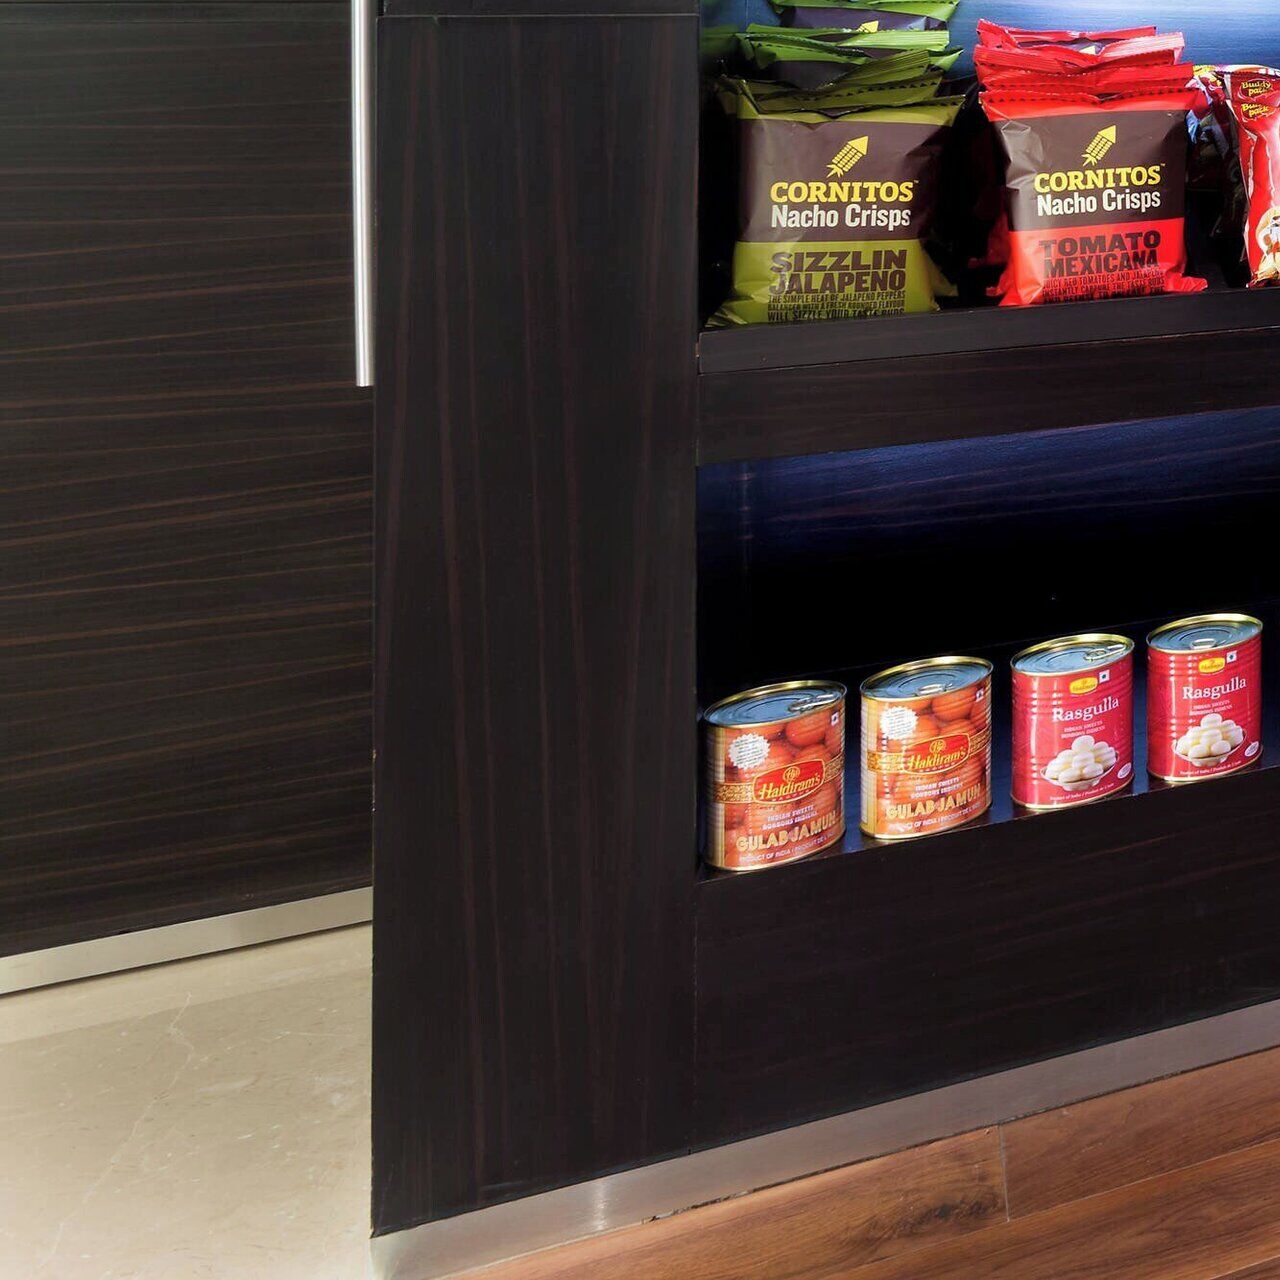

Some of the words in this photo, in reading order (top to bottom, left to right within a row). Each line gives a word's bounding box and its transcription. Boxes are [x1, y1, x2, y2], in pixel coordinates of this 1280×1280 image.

[770, 181, 914, 203] CORNITOS
[1034, 165, 1161, 193] CORNITOS
[1037, 191, 1098, 217] Nacho
[1102, 188, 1161, 213] Crisps
[771, 204, 839, 228] Nacho
[844, 203, 912, 231] Crisps
[1039, 230, 1161, 257] TOMATO
[769, 249, 908, 274] SIZZLIN
[1043, 249, 1159, 279] MEXICANA
[768, 270, 906, 295] JALAPENO
[783, 294, 809, 303] SIMPLE
[811, 293, 828, 303] HEAT
[840, 291, 875, 302] JALAPENO
[876, 290, 906, 301] PEPPERS
[1181, 676, 1247, 699] Rasgulla
[1052, 695, 1120, 723] Rasgulla
[908, 746, 967, 769] Haldiram's
[759, 772, 822, 800] Haldiram's
[885, 799, 935, 820] GULAB
[936, 783, 981, 811] JAMUN
[736, 827, 788, 852] GULAB
[788, 810, 837, 842] JAMUN
